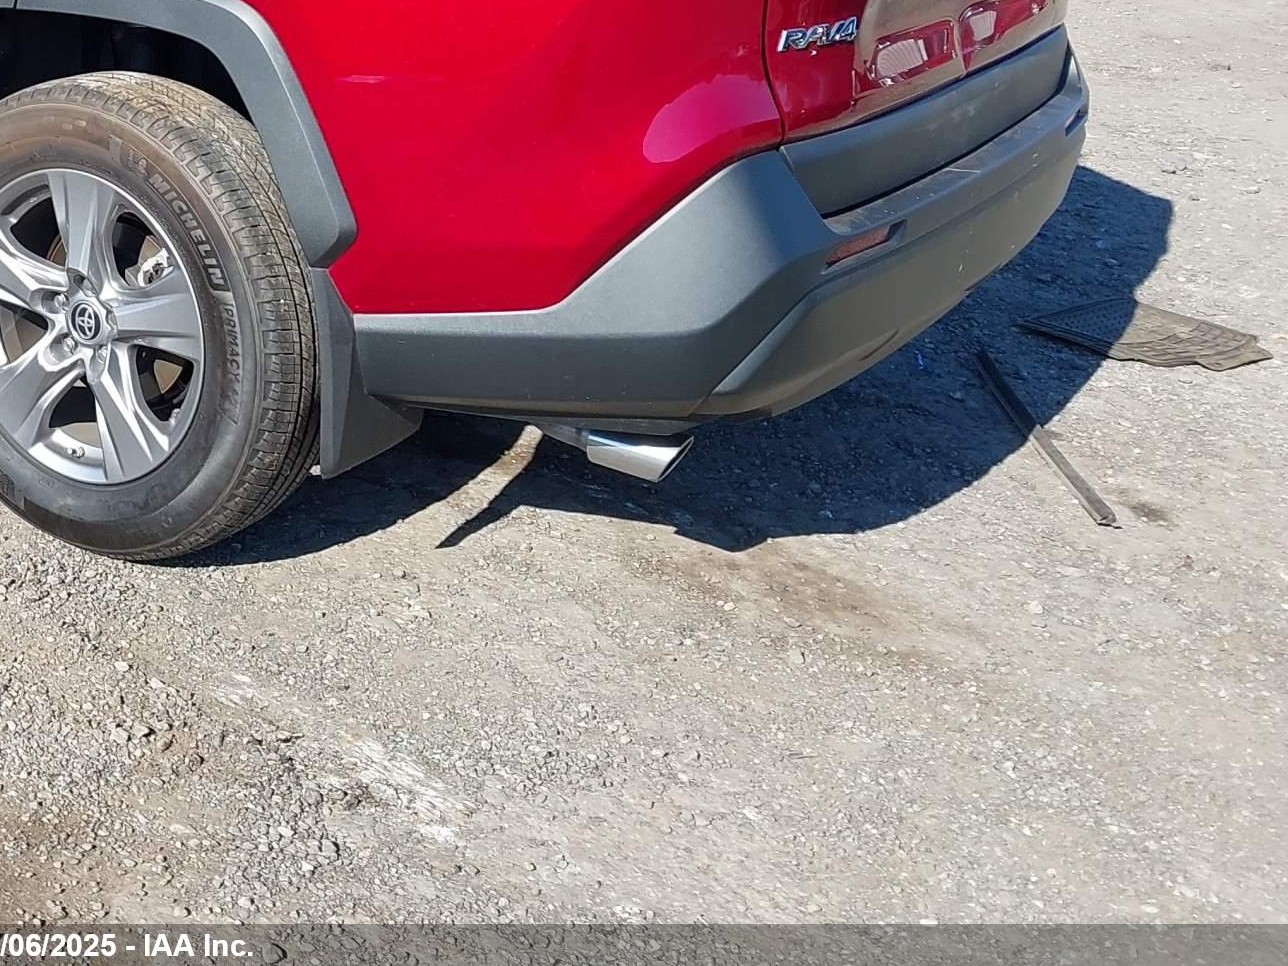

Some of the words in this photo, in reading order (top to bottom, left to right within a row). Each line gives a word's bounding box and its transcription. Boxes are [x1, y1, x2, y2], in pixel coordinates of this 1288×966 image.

[777, 16, 857, 52] RAV4
[148, 173, 227, 285] MICHELIN
[223, 305, 241, 384] PRIMACY
